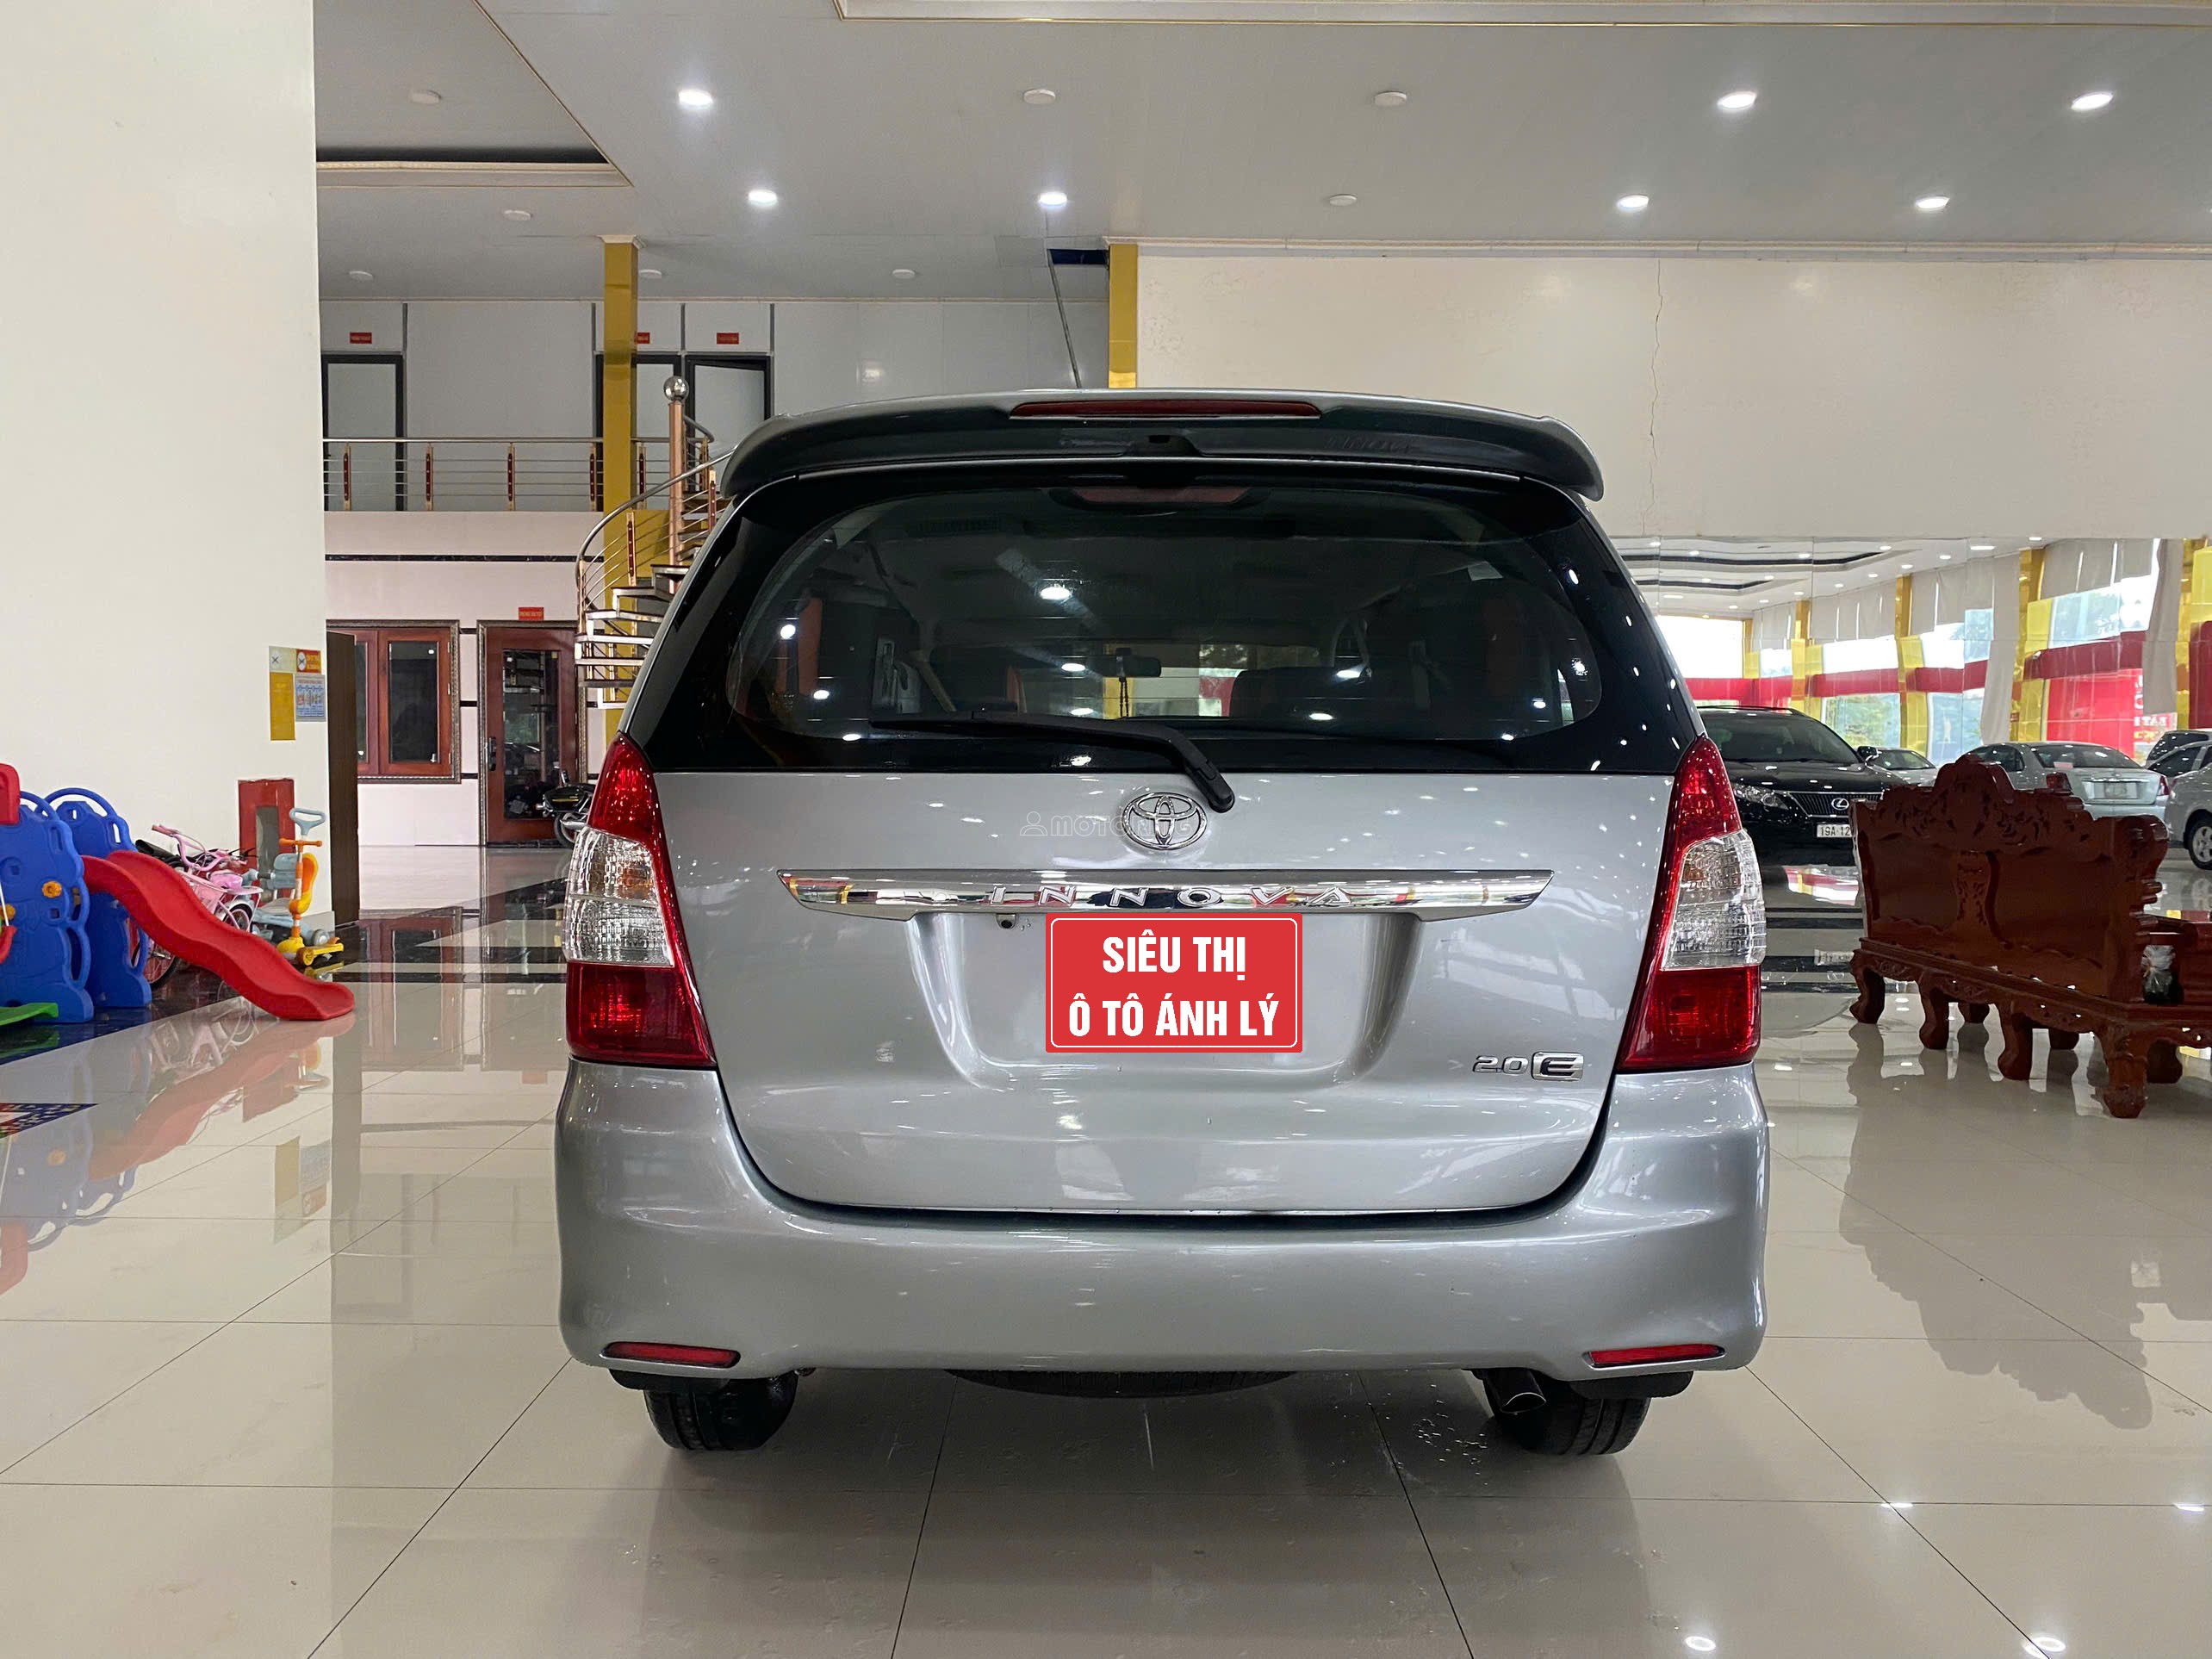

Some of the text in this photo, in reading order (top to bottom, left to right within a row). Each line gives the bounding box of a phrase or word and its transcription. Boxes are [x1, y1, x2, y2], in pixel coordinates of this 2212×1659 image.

[991, 885, 1351, 907] INNOVA
[1472, 1055, 1579, 1078] 2.0 E
